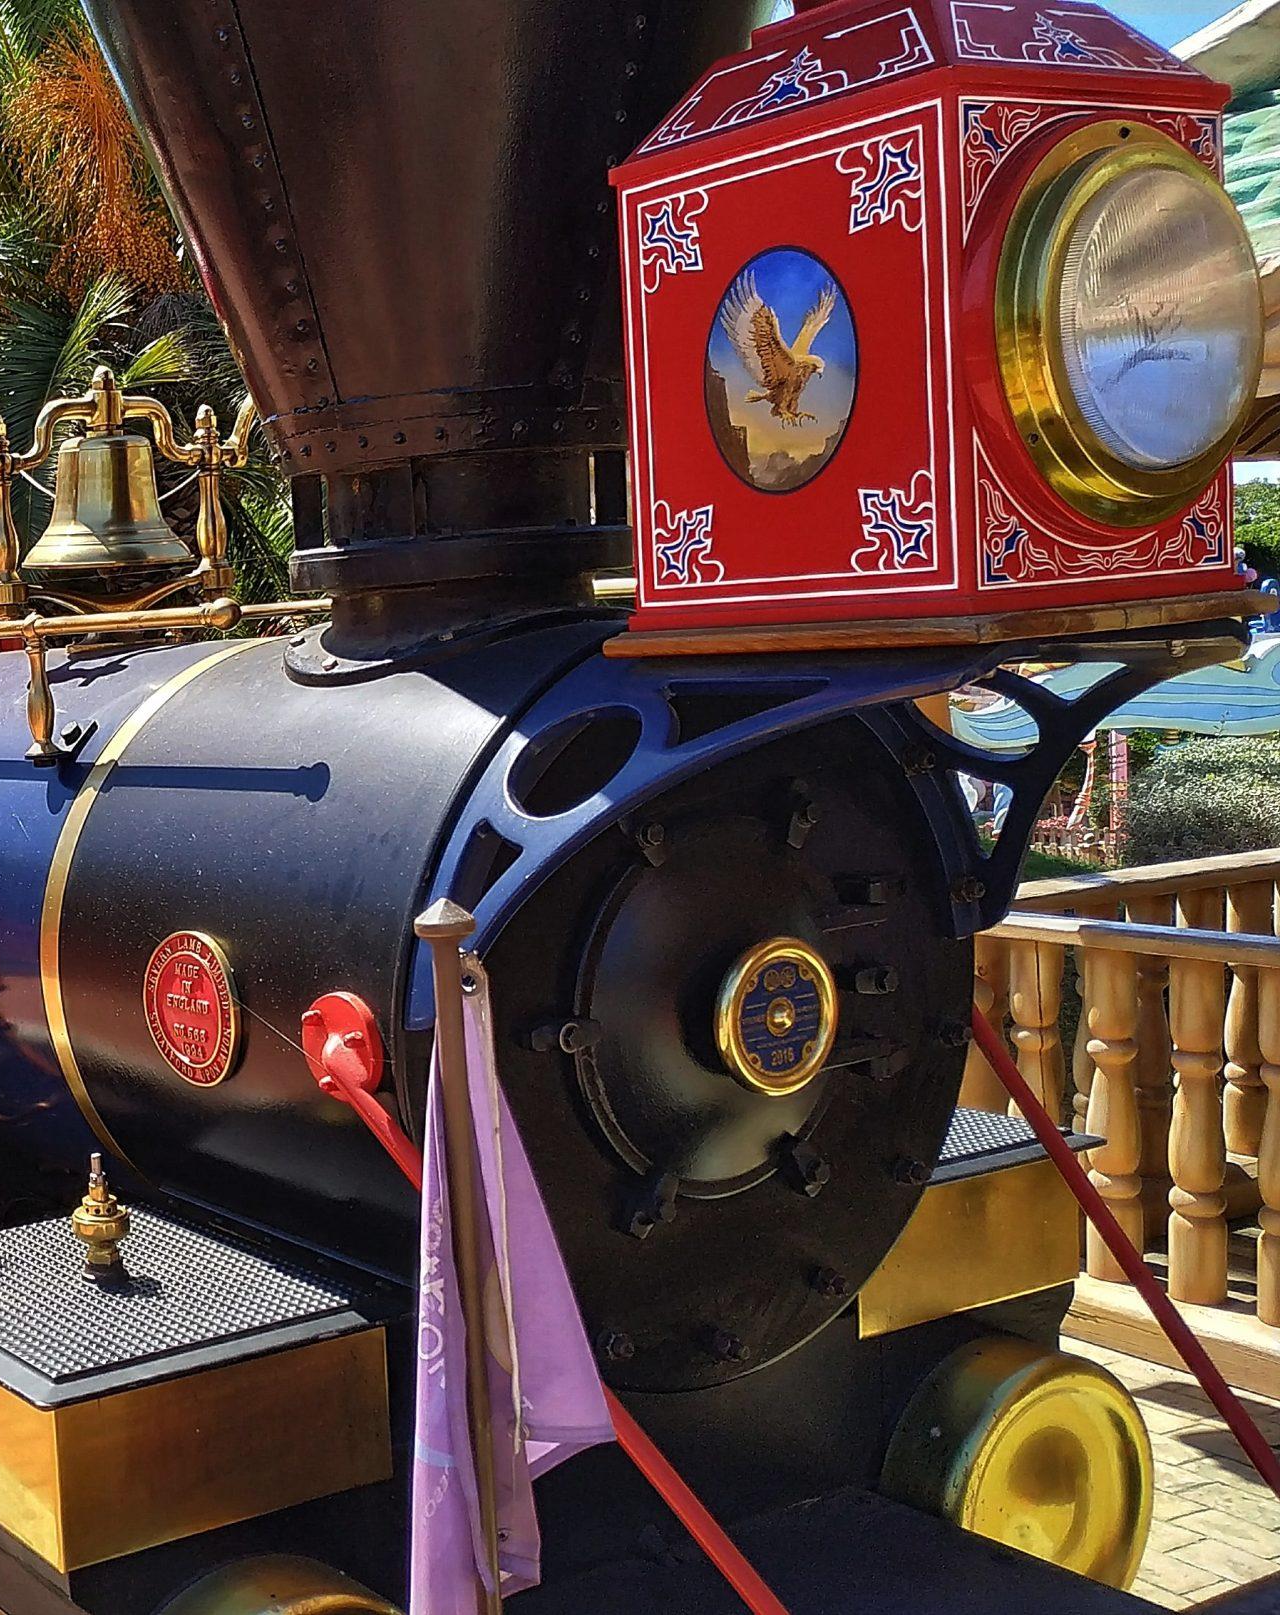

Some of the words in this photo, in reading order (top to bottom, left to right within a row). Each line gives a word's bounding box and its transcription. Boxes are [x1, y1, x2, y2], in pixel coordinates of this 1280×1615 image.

[148, 944, 173, 993] SEVERN
[177, 937, 202, 953] LAMB
[205, 952, 230, 1010] LIMITED
[174, 962, 200, 979] MADE
[181, 980, 193, 994] IN
[166, 993, 210, 1014] ENGLAND
[149, 1012, 194, 1078] STRATFORD
[200, 1062, 222, 1082] UPON
[219, 1027, 232, 1069] AVON
